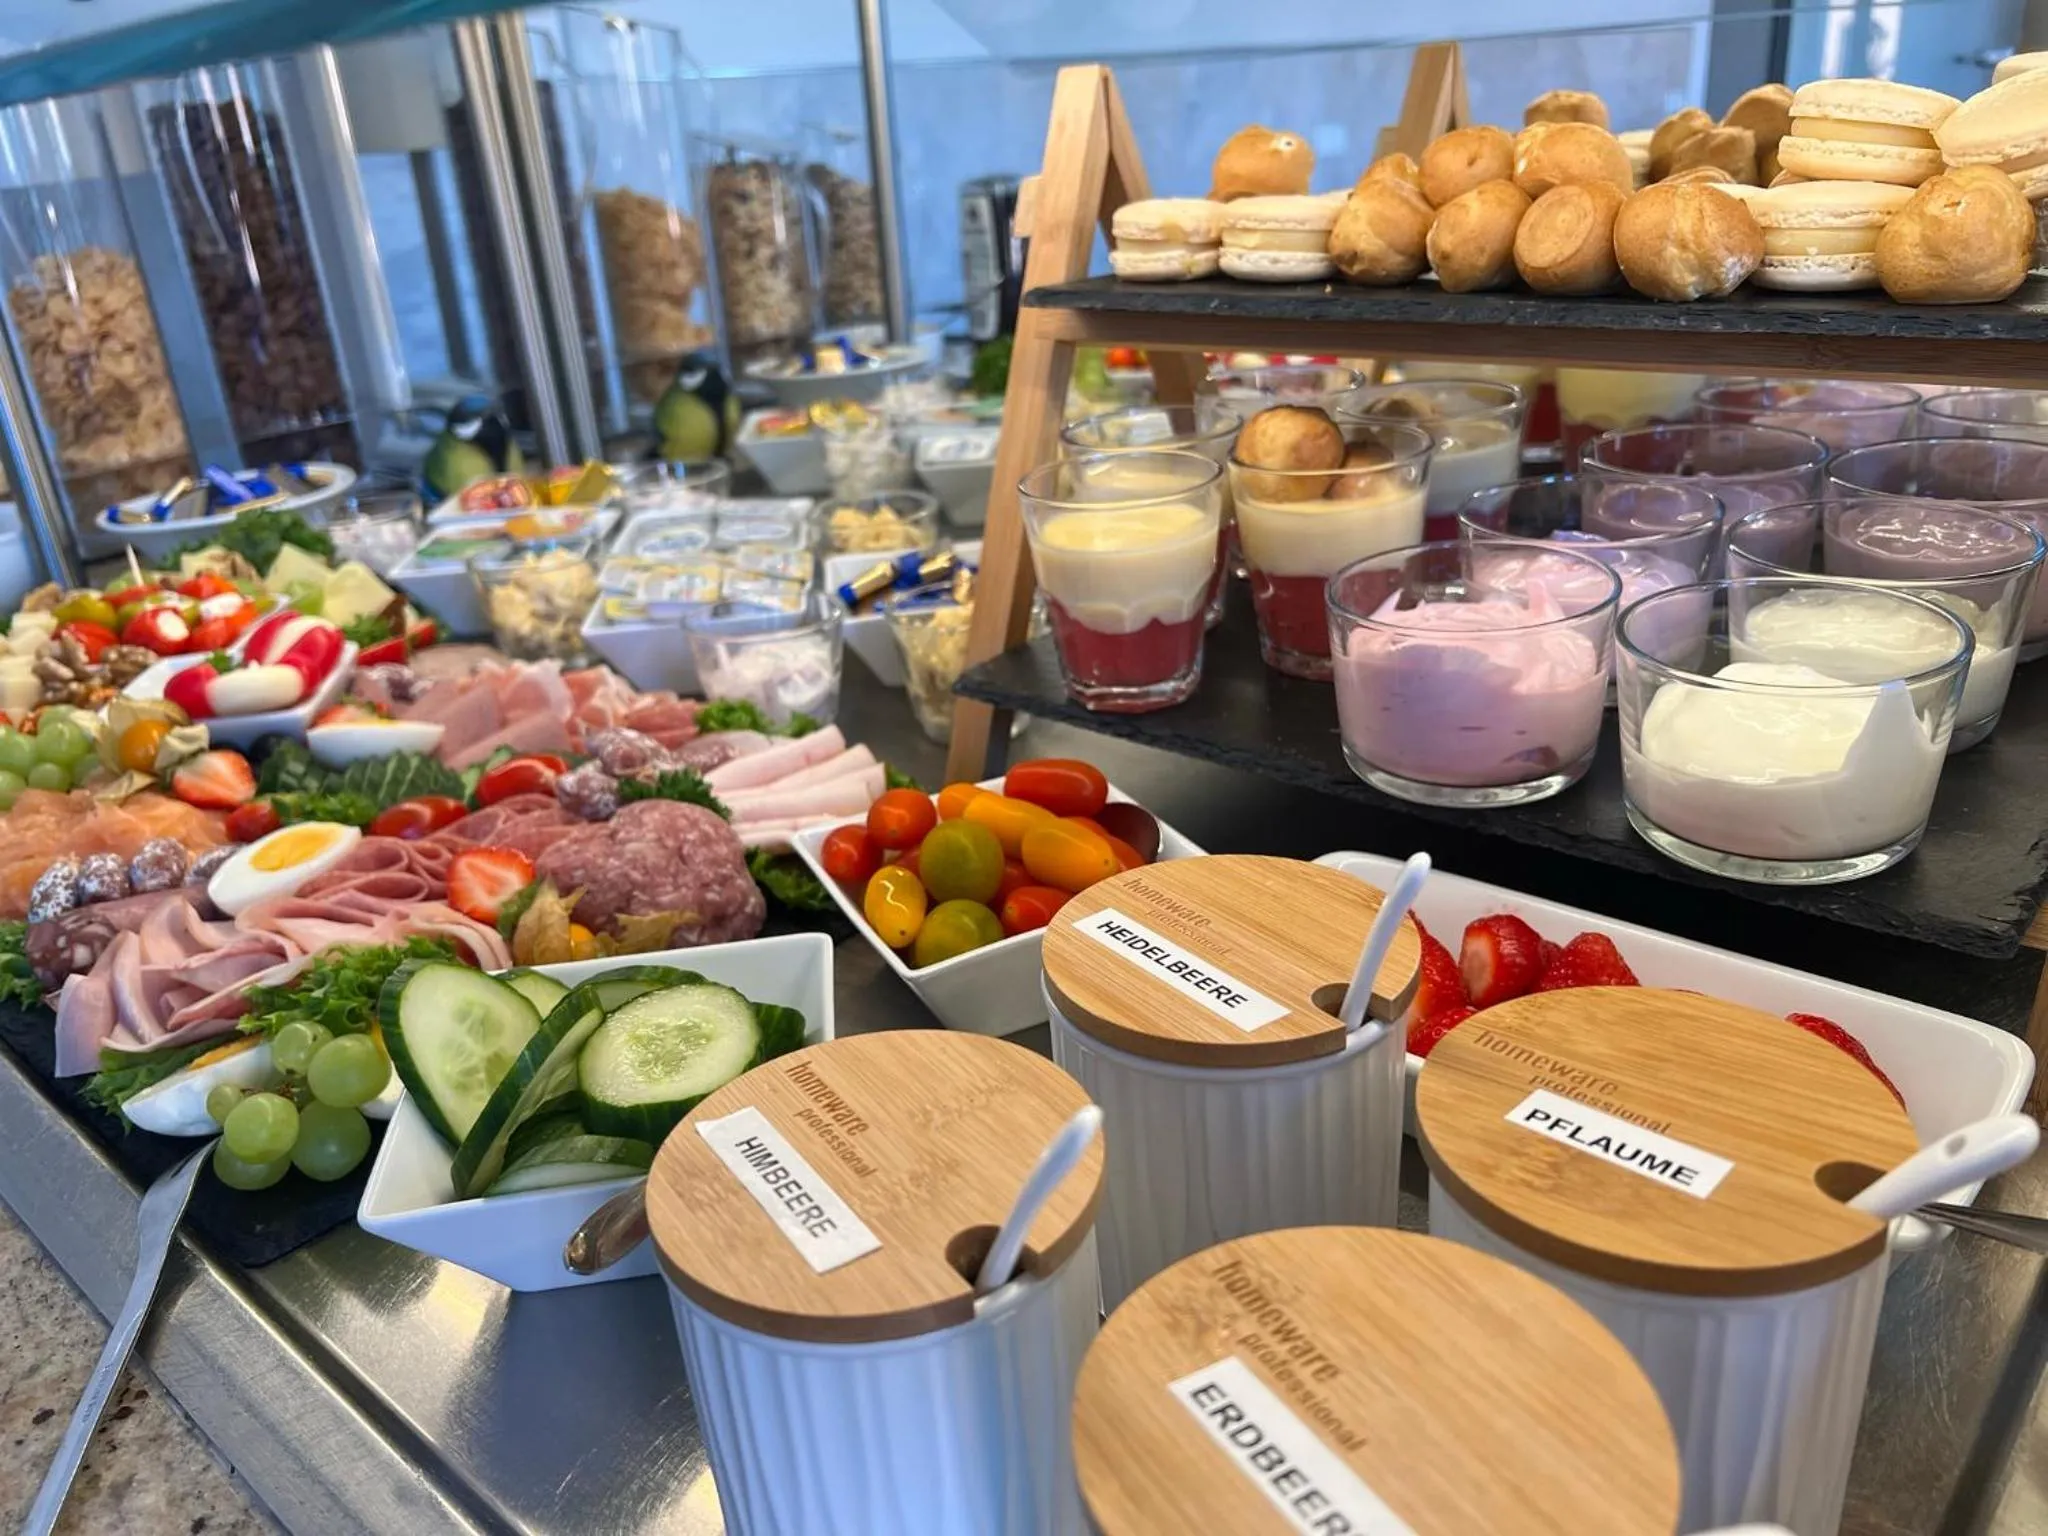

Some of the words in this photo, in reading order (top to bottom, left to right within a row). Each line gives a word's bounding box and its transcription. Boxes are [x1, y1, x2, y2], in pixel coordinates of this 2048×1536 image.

[1122, 878, 1212, 927] homeware
[1096, 920, 1248, 1009] HEIDELBEERE
[785, 1061, 869, 1136] homeware
[1473, 1030, 1619, 1096] homeware
[794, 1106, 878, 1179] professional
[1529, 1075, 1672, 1135] professional
[1524, 1108, 1700, 1186] PFLAUME
[735, 1135, 838, 1239] HIMBEERE
[1212, 1260, 1340, 1383] homeware
[1236, 1332, 1367, 1453] professional
[1189, 1381, 1363, 1536] ERDBEER
